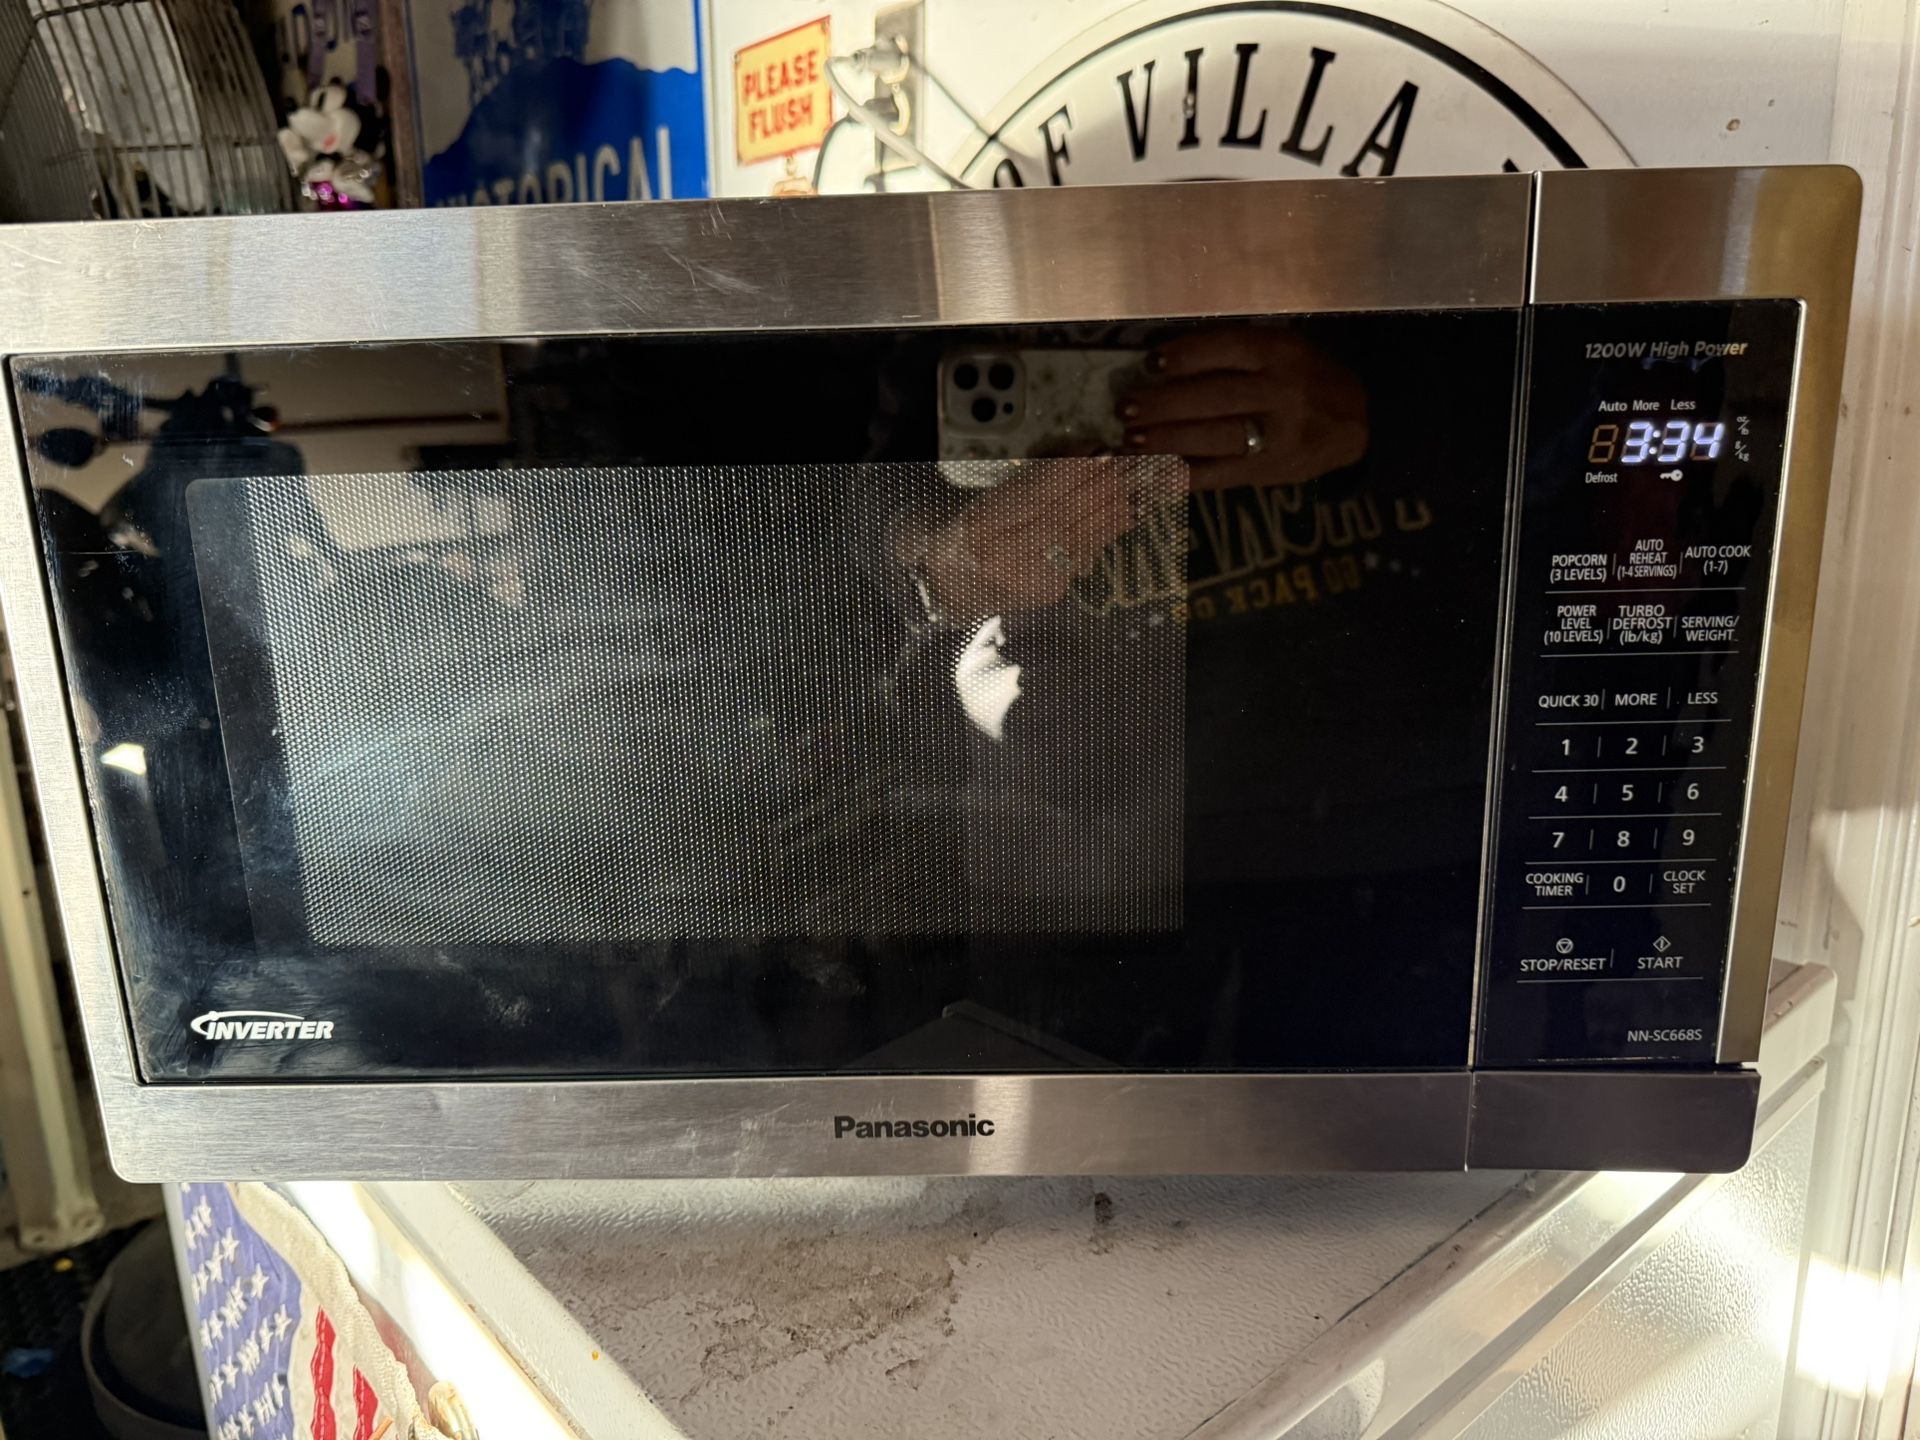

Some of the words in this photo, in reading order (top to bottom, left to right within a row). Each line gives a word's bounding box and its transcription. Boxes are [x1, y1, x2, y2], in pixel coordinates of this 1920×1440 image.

[743, 49, 818, 104] PLEASE
[749, 92, 813, 142] FLUSH
[1117, 43, 1420, 177] VILLA
[1585, 342, 1645, 358] 1200W
[1650, 342, 1689, 360] High
[1694, 341, 1748, 357] Power
[1598, 401, 1627, 412] Auto
[1632, 400, 1660, 411] More
[1670, 399, 1696, 411] Less
[1620, 420, 1725, 463] 3:34
[1585, 472, 1618, 484] Defrost
[1635, 539, 1664, 551] AUTO
[1685, 547, 1716, 559] AUTO
[1719, 545, 1751, 558] COOK
[1552, 554, 1607, 566] POPCORN
[1629, 552, 1667, 564] REHEAT
[1617, 565, 1634, 581] (1-4
[1634, 564, 1677, 580] SERVINGS)
[1703, 560, 1728, 575] (1-7)
[1550, 569, 1561, 583] (3
[1564, 568, 1607, 582] LEVELS)
[1557, 605, 1597, 617] POWER
[1618, 604, 1665, 617] TURBO
[1561, 618, 1592, 629] LEVEL
[1613, 617, 1673, 630] DEFROST
[1681, 616, 1740, 629] SERVING/
[1544, 631, 1560, 645] (10
[1561, 629, 1604, 644] LEVELS)
[1619, 631, 1663, 645] (lb/kg)
[1686, 629, 1735, 642] WEIGHT
[1538, 694, 1580, 708] QUICK
[1583, 694, 1600, 707] 30
[1615, 693, 1658, 706] MORE
[1688, 692, 1718, 705] LESS
[1562, 738, 1571, 756] 1
[1625, 737, 1638, 755] 2
[1691, 736, 1704, 753] 3
[1554, 785, 1568, 802] 4
[1621, 784, 1634, 801] 5
[1687, 783, 1699, 800] 6
[1552, 831, 1565, 848] 7
[1617, 830, 1630, 847] 8
[1682, 829, 1695, 846] 9
[1525, 872, 1584, 885] COOKING
[1663, 870, 1706, 882] CLOCK
[1535, 885, 1573, 896] TIMER
[1613, 876, 1626, 892] 0
[1673, 882, 1695, 894] SET
[1520, 957, 1606, 971] STOP/RESET
[1637, 956, 1683, 969] START
[205, 1020, 335, 1041] INVERTER
[1627, 1029, 1702, 1042] NN-SC668S
[834, 1113, 995, 1139] Panasonic
